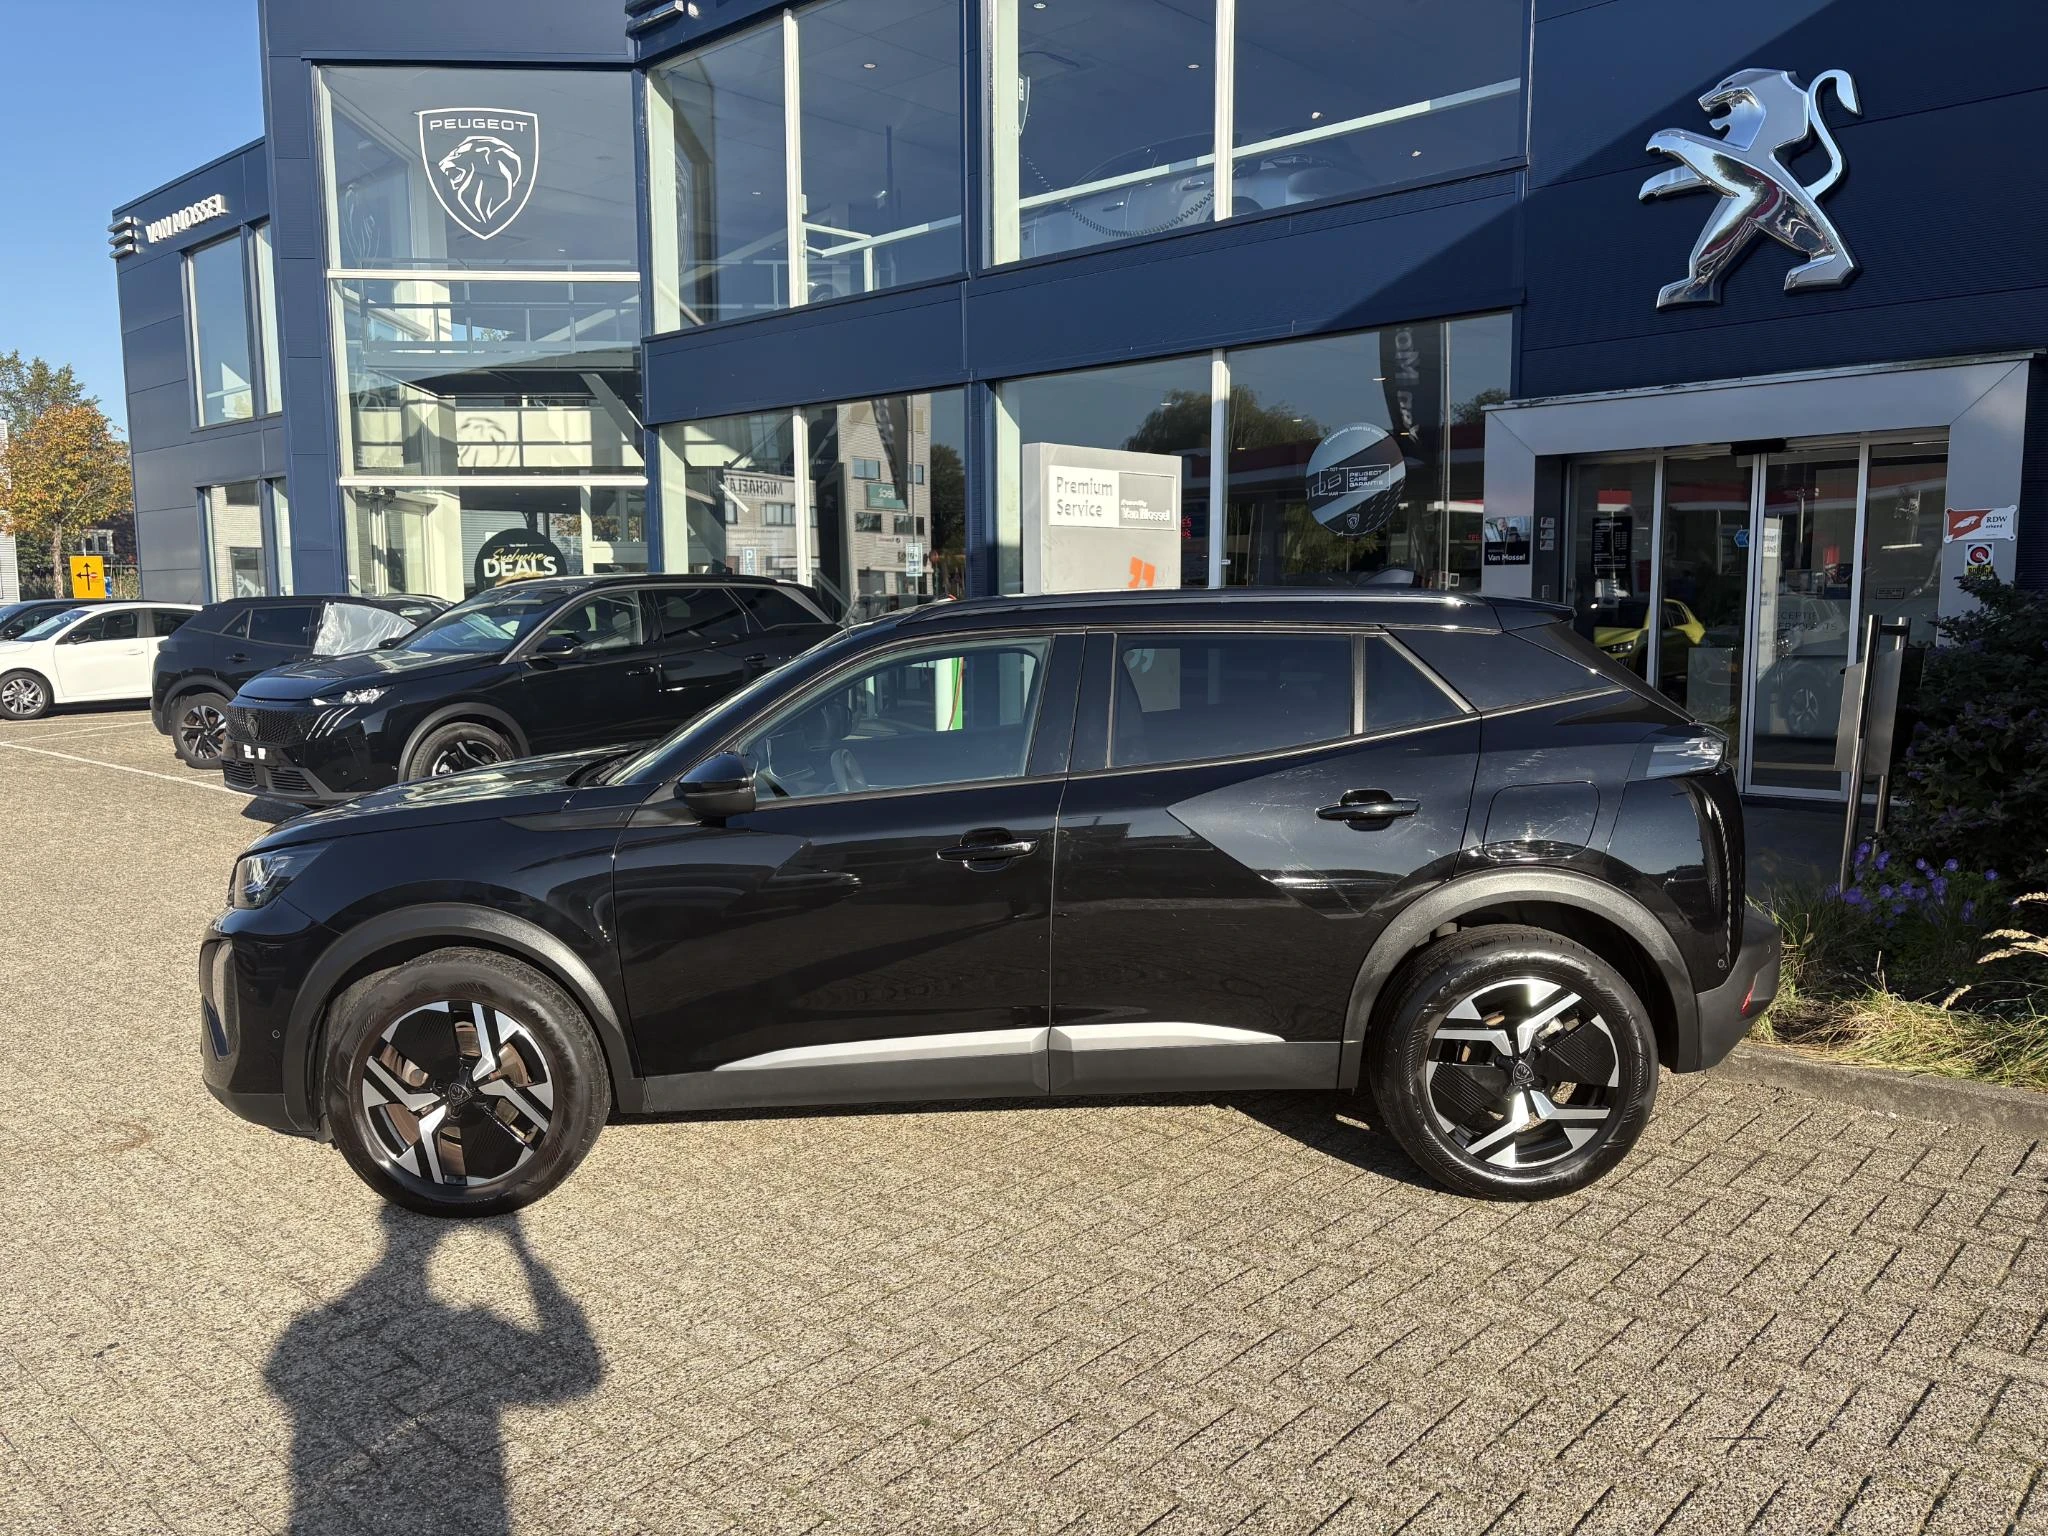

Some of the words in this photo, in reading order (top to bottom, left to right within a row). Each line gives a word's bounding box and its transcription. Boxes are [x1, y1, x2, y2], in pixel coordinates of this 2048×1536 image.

[429, 118, 528, 132] PEUGEOT
[145, 216, 173, 243] VAN
[172, 194, 230, 232] MOSSEL
[1056, 476, 1113, 496] Premium
[1349, 480, 1384, 488] GARANTIE
[1056, 499, 1103, 517] Service
[1121, 507, 1139, 520] Van
[1140, 508, 1170, 521] Mossel
[1986, 515, 2008, 523] RDW
[490, 547, 548, 562] Exclusive
[1501, 553, 1526, 561] Mossel
[483, 556, 558, 577] DEALS
